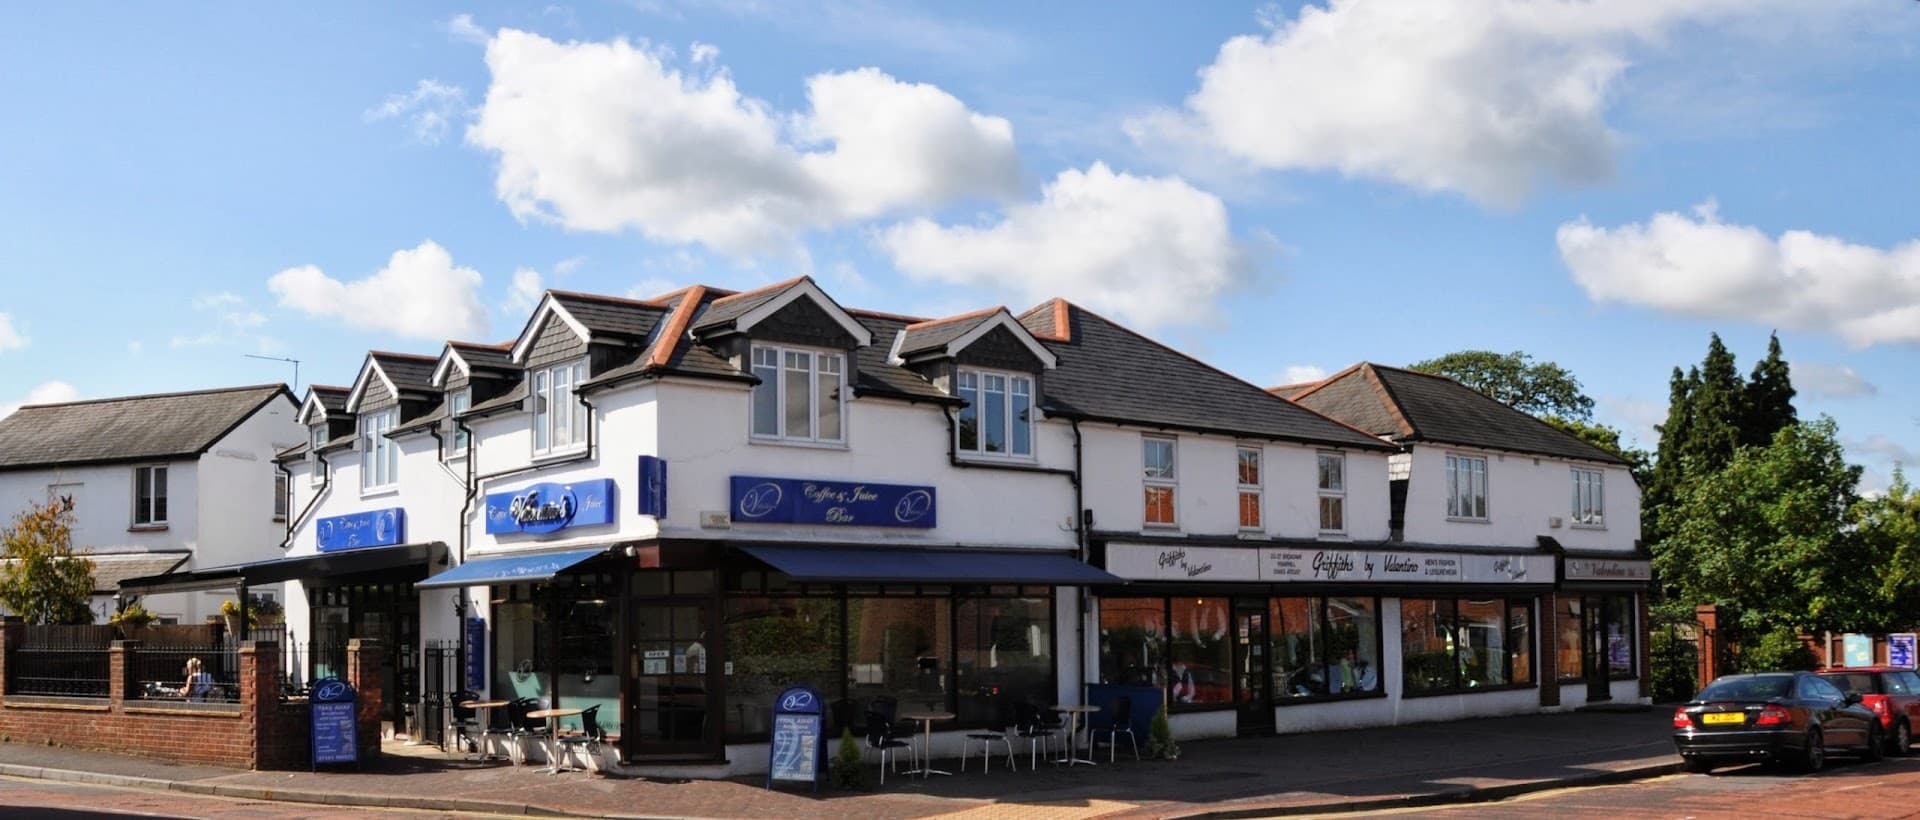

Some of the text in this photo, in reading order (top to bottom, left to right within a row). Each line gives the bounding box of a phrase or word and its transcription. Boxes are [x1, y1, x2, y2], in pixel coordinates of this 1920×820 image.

[803, 483, 835, 503] Coffee
[846, 485, 878, 502] Juice
[826, 507, 855, 523] Bar
[1313, 552, 1419, 579] Griffiths by Valentino
